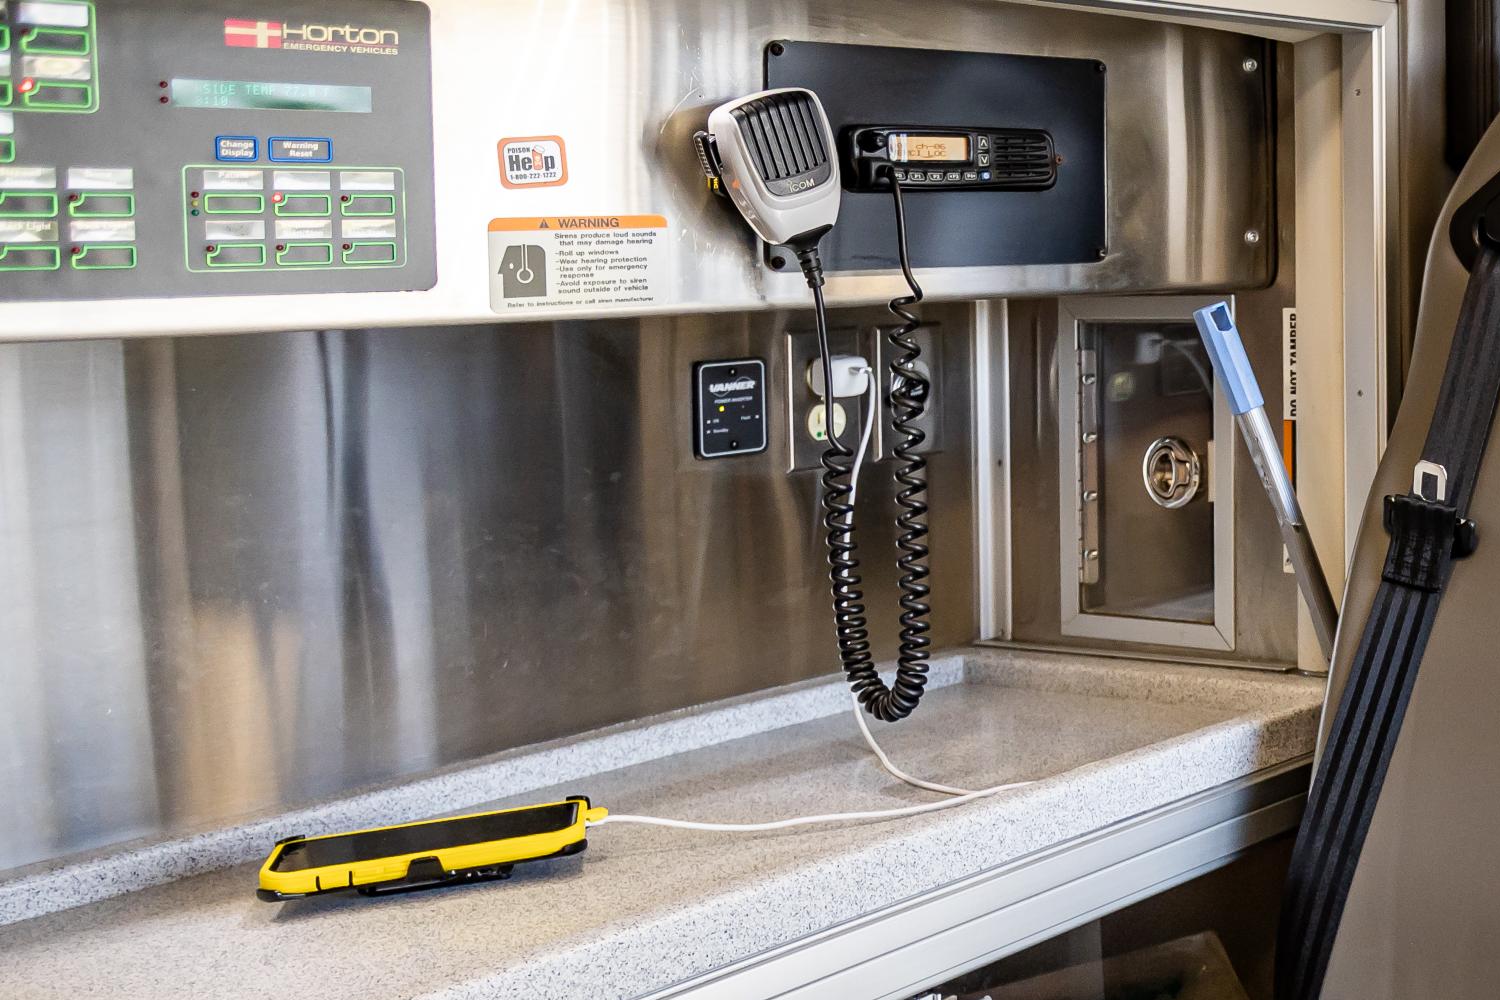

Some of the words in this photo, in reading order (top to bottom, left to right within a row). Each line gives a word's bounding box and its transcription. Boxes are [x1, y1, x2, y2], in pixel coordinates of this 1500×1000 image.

[283, 23, 398, 45] Horton
[283, 42, 348, 54] EMERGENCY
[350, 47, 398, 56] VEHICLES
[220, 140, 254, 149] Change
[283, 142, 318, 150] Warning
[221, 149, 254, 158] Display
[558, 218, 620, 228] WARNING
[709, 380, 755, 392] VANNER
